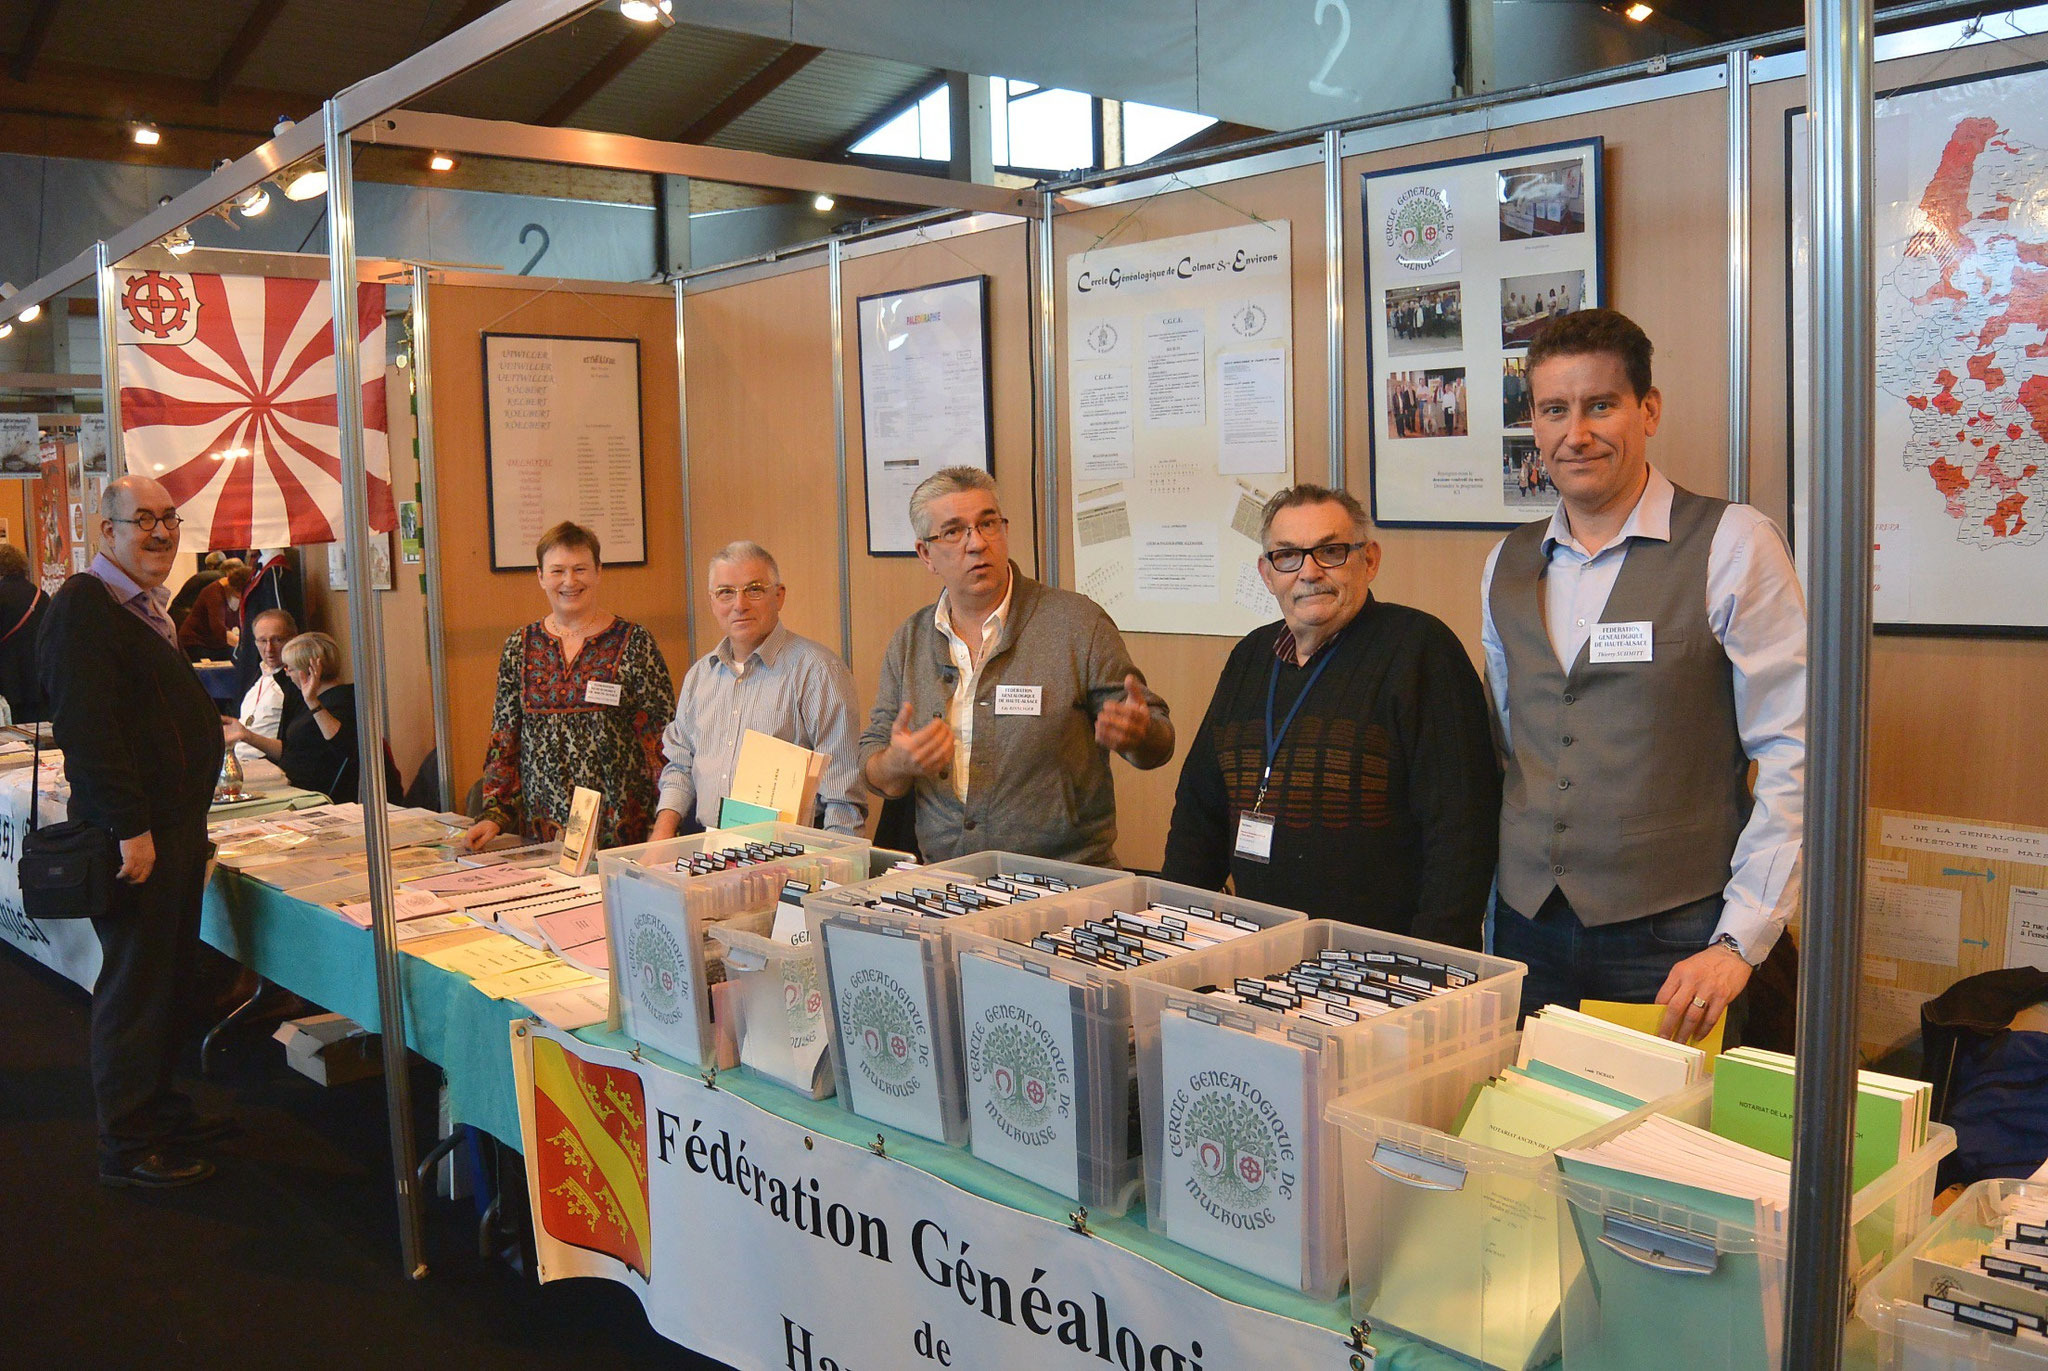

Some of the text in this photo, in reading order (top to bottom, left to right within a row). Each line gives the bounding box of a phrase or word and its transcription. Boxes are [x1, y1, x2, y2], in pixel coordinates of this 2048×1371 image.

[1308, 0, 1359, 102] 2
[1445, 225, 1454, 241] DE
[1077, 271, 1108, 293] Cercle
[1109, 268, 1165, 289] Généalogique
[1166, 267, 1175, 276] de
[1177, 257, 1215, 279] Colmar
[1232, 250, 1278, 272] Environs
[1899, 835, 1979, 850] L'HISTOIRE
[1986, 846, 2009, 854] DES
[1912, 824, 1929, 832] DE
[1959, 830, 2041, 845] GENEALOGIE
[681, 981, 689, 1000] DE
[842, 968, 929, 1098] CERCLE GENEALOGIQUE DE MULHOUSE
[970, 1004, 1071, 1146] CERCLE GENEALOGIQUE DE MULHOUSE
[1739, 1101, 1769, 1113] NOTARIAT
[1168, 1070, 1295, 1231] CERCLE GENEALOGIQUE DE MULHOUSE
[1490, 1124, 1517, 1138] NOTARIAT
[655, 1107, 892, 1263] Fédération
[914, 1320, 952, 1367] de
